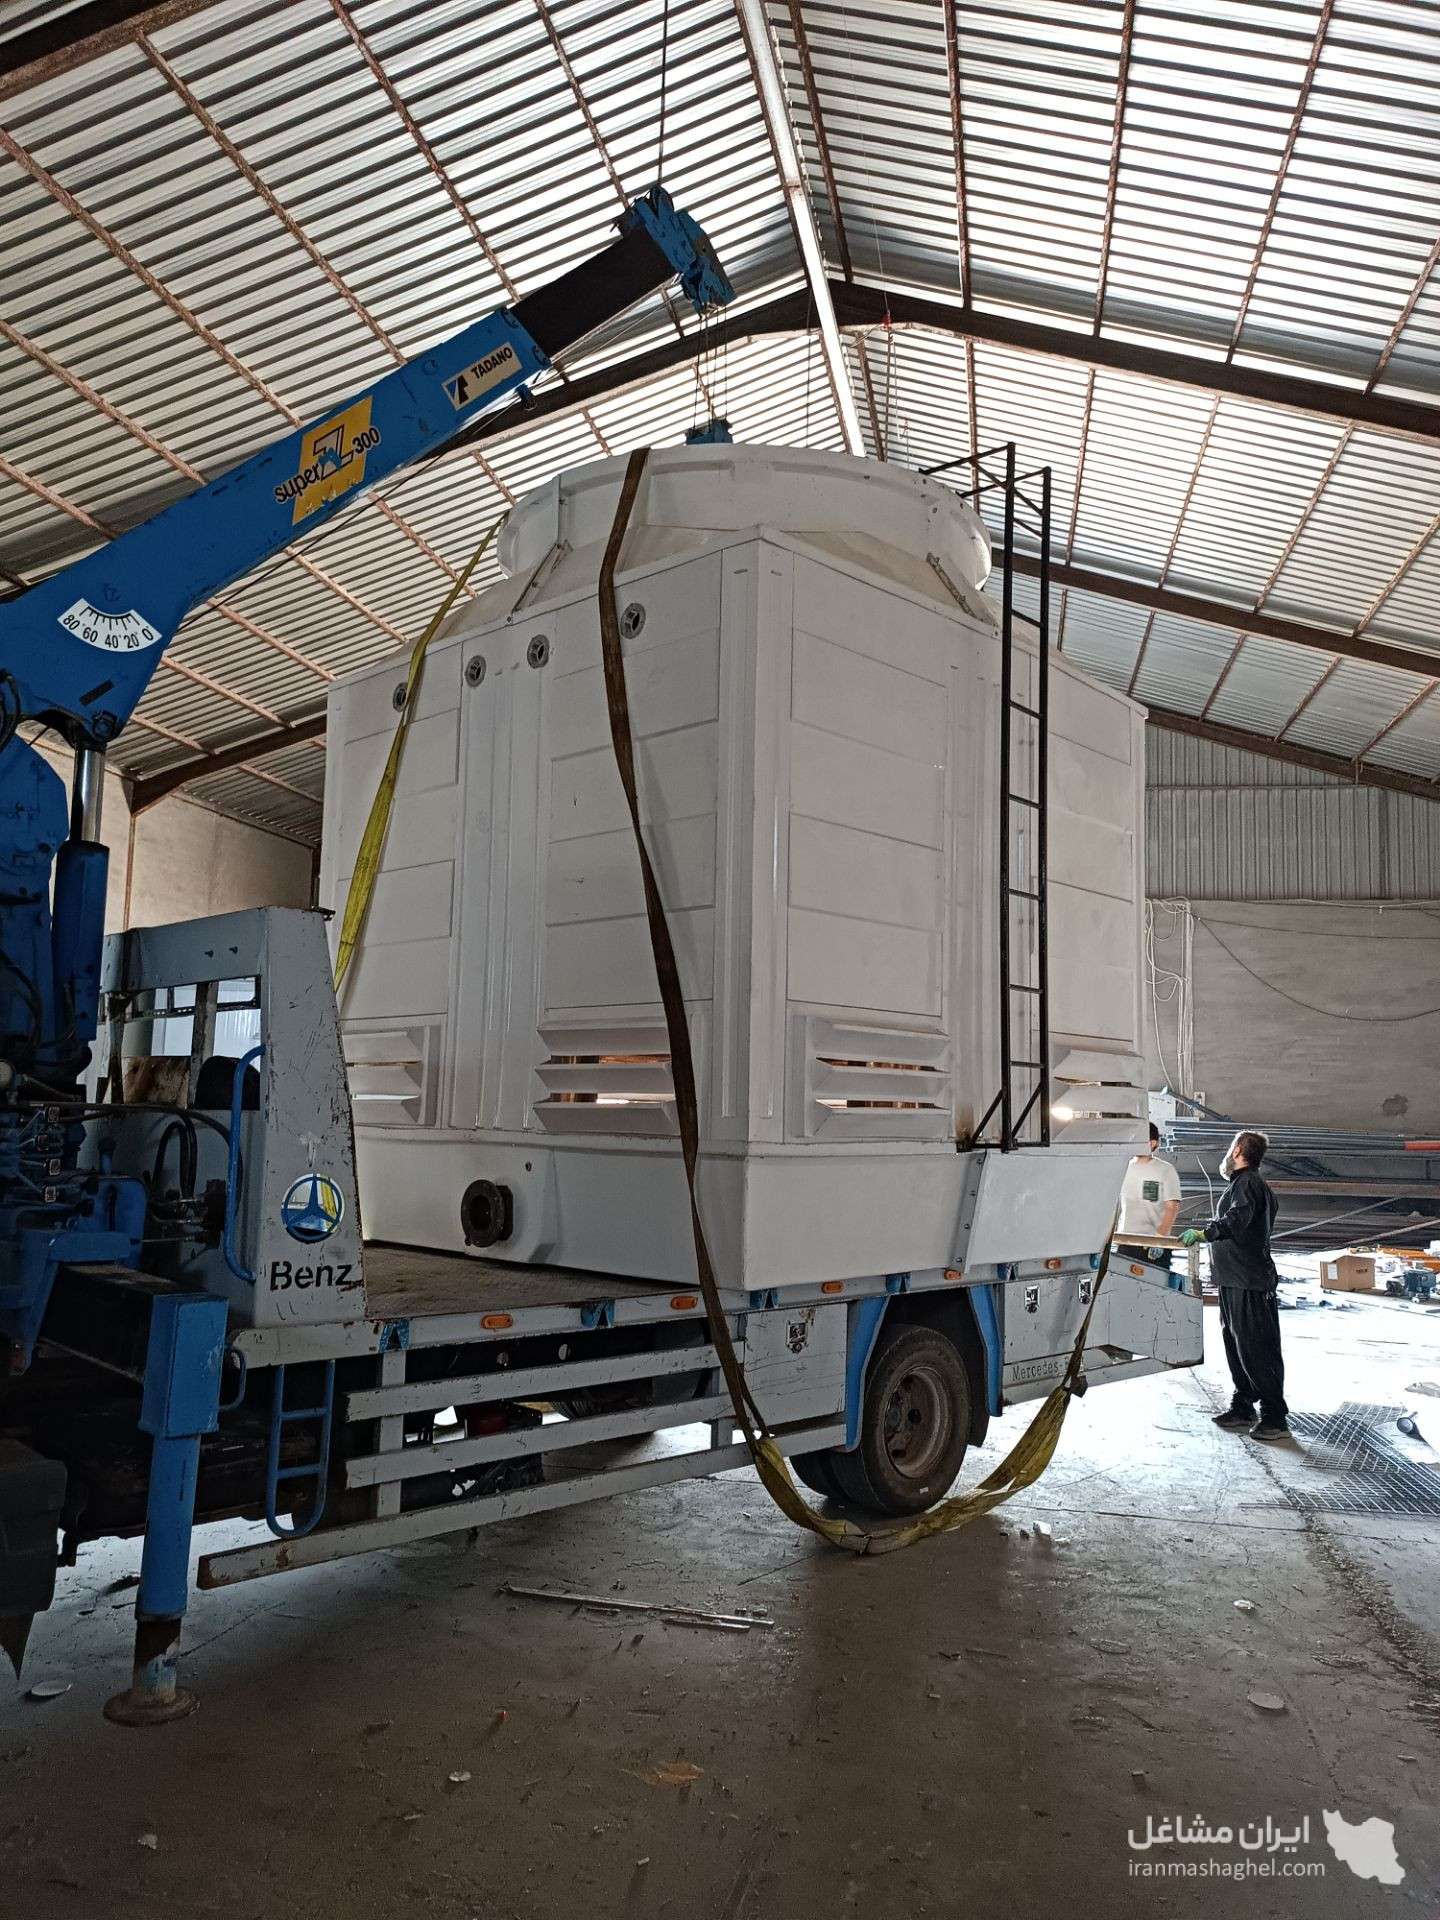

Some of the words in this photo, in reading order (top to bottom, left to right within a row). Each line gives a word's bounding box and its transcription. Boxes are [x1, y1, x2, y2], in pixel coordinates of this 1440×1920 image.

[471, 347, 512, 379] TADANO
[274, 464, 319, 503] super
[352, 427, 380, 454] 300
[270, 1261, 353, 1291] Benz
[1012, 1356, 1083, 1381] Mercedes-
